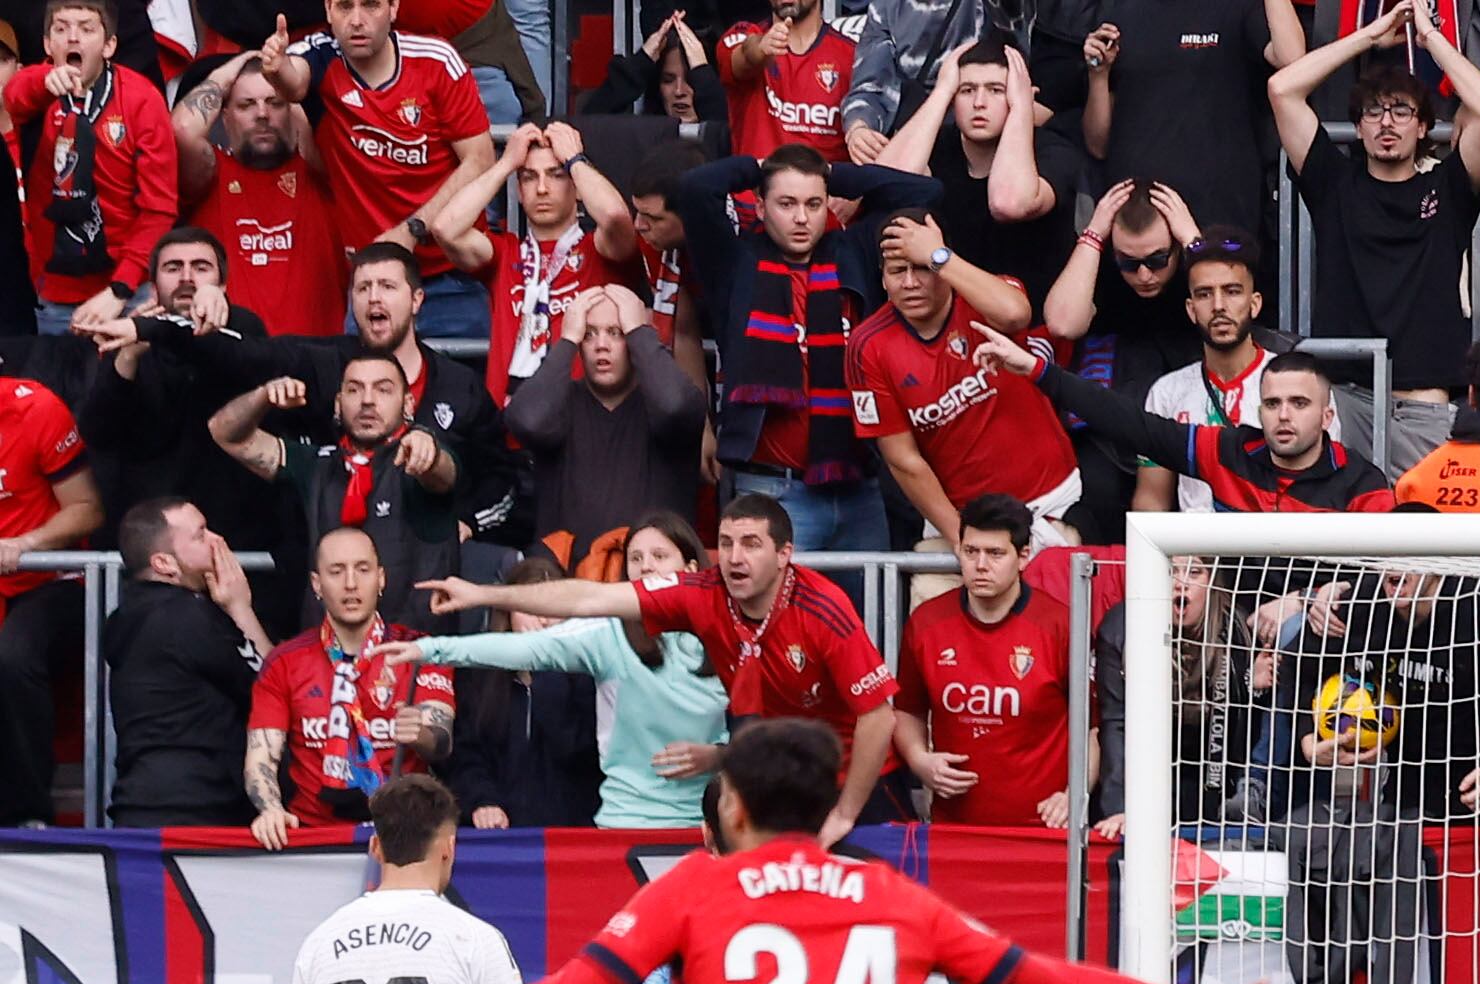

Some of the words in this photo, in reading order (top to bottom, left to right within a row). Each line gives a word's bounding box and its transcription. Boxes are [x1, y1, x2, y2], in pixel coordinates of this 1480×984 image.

[1436, 487, 1479, 507] 223
[942, 683, 1021, 716] can
[1210, 715, 1224, 754] LOLA
[738, 863, 866, 904] CATENA
[331, 920, 433, 963] ASENCIO
